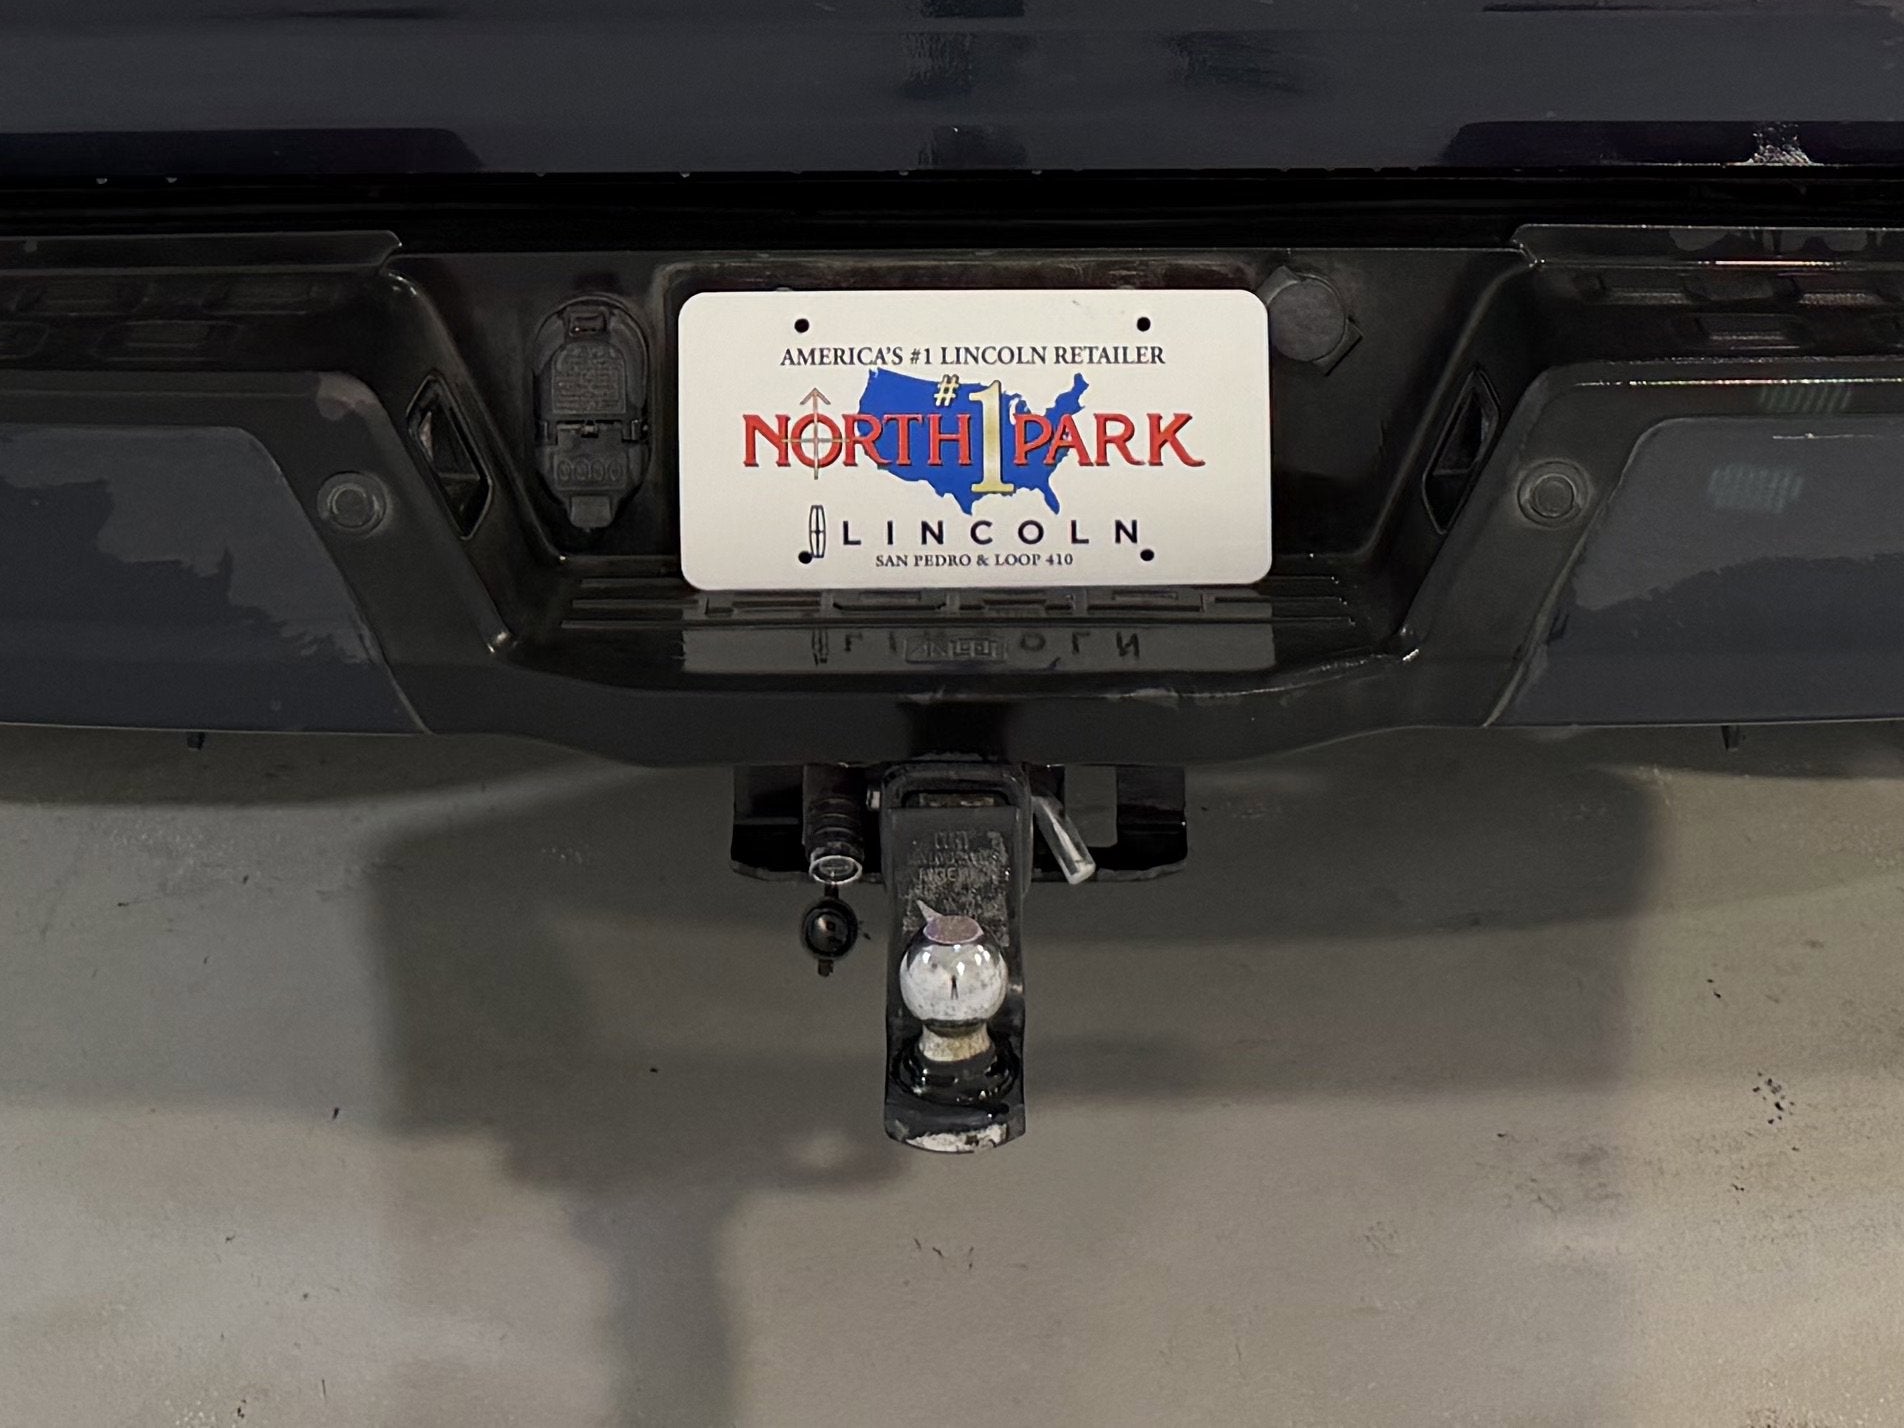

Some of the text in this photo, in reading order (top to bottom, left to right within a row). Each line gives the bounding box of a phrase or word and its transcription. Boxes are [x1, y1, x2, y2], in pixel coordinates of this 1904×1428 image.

[780, 345, 1166, 366] AMERICA'S #1 LINCOLN RETAILER
[742, 412, 1206, 467] NORTH PARK
[843, 519, 1138, 545] LINCOLN
[876, 552, 1073, 567] SAN PEDRO & LOOP 410
